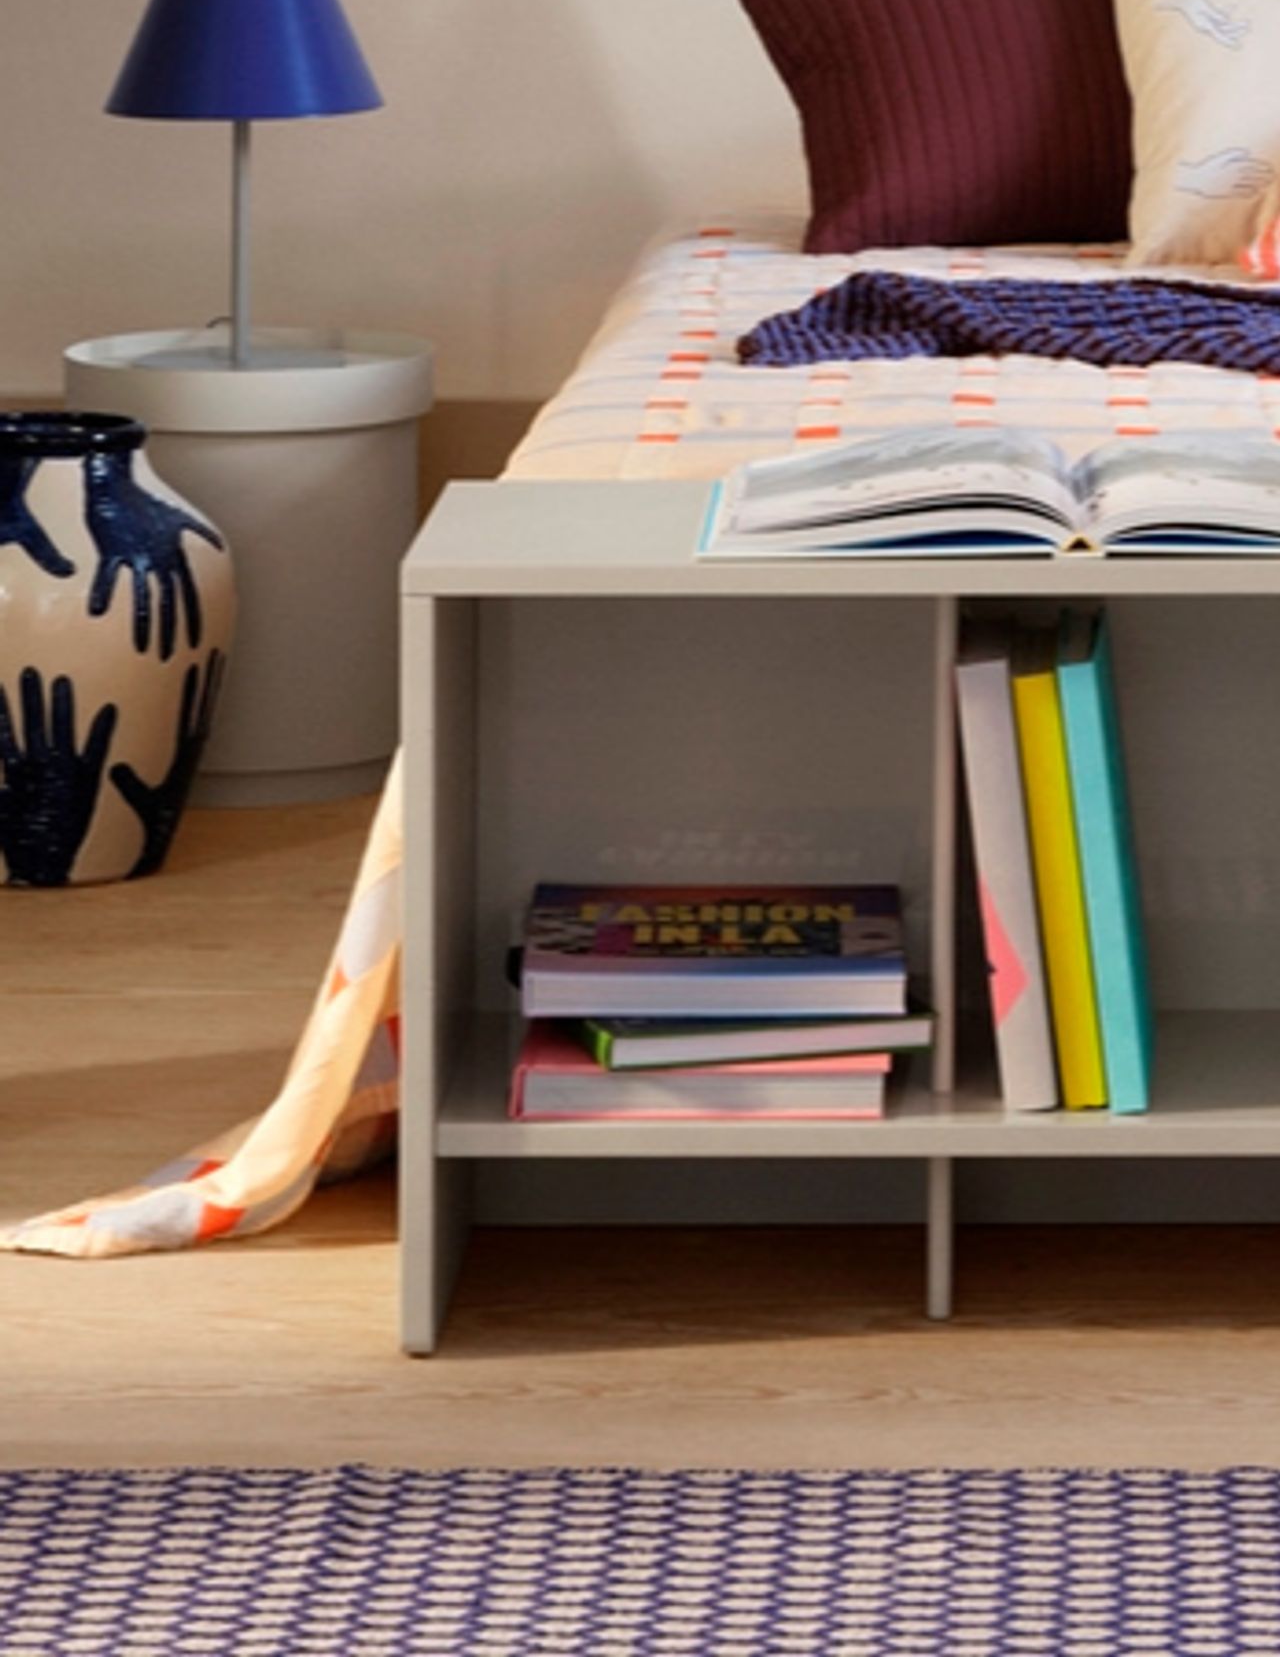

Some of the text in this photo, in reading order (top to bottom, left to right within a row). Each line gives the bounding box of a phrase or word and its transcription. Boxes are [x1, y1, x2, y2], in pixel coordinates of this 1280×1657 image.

[578, 904, 856, 923] FASHION
[632, 925, 803, 944] IN LA
